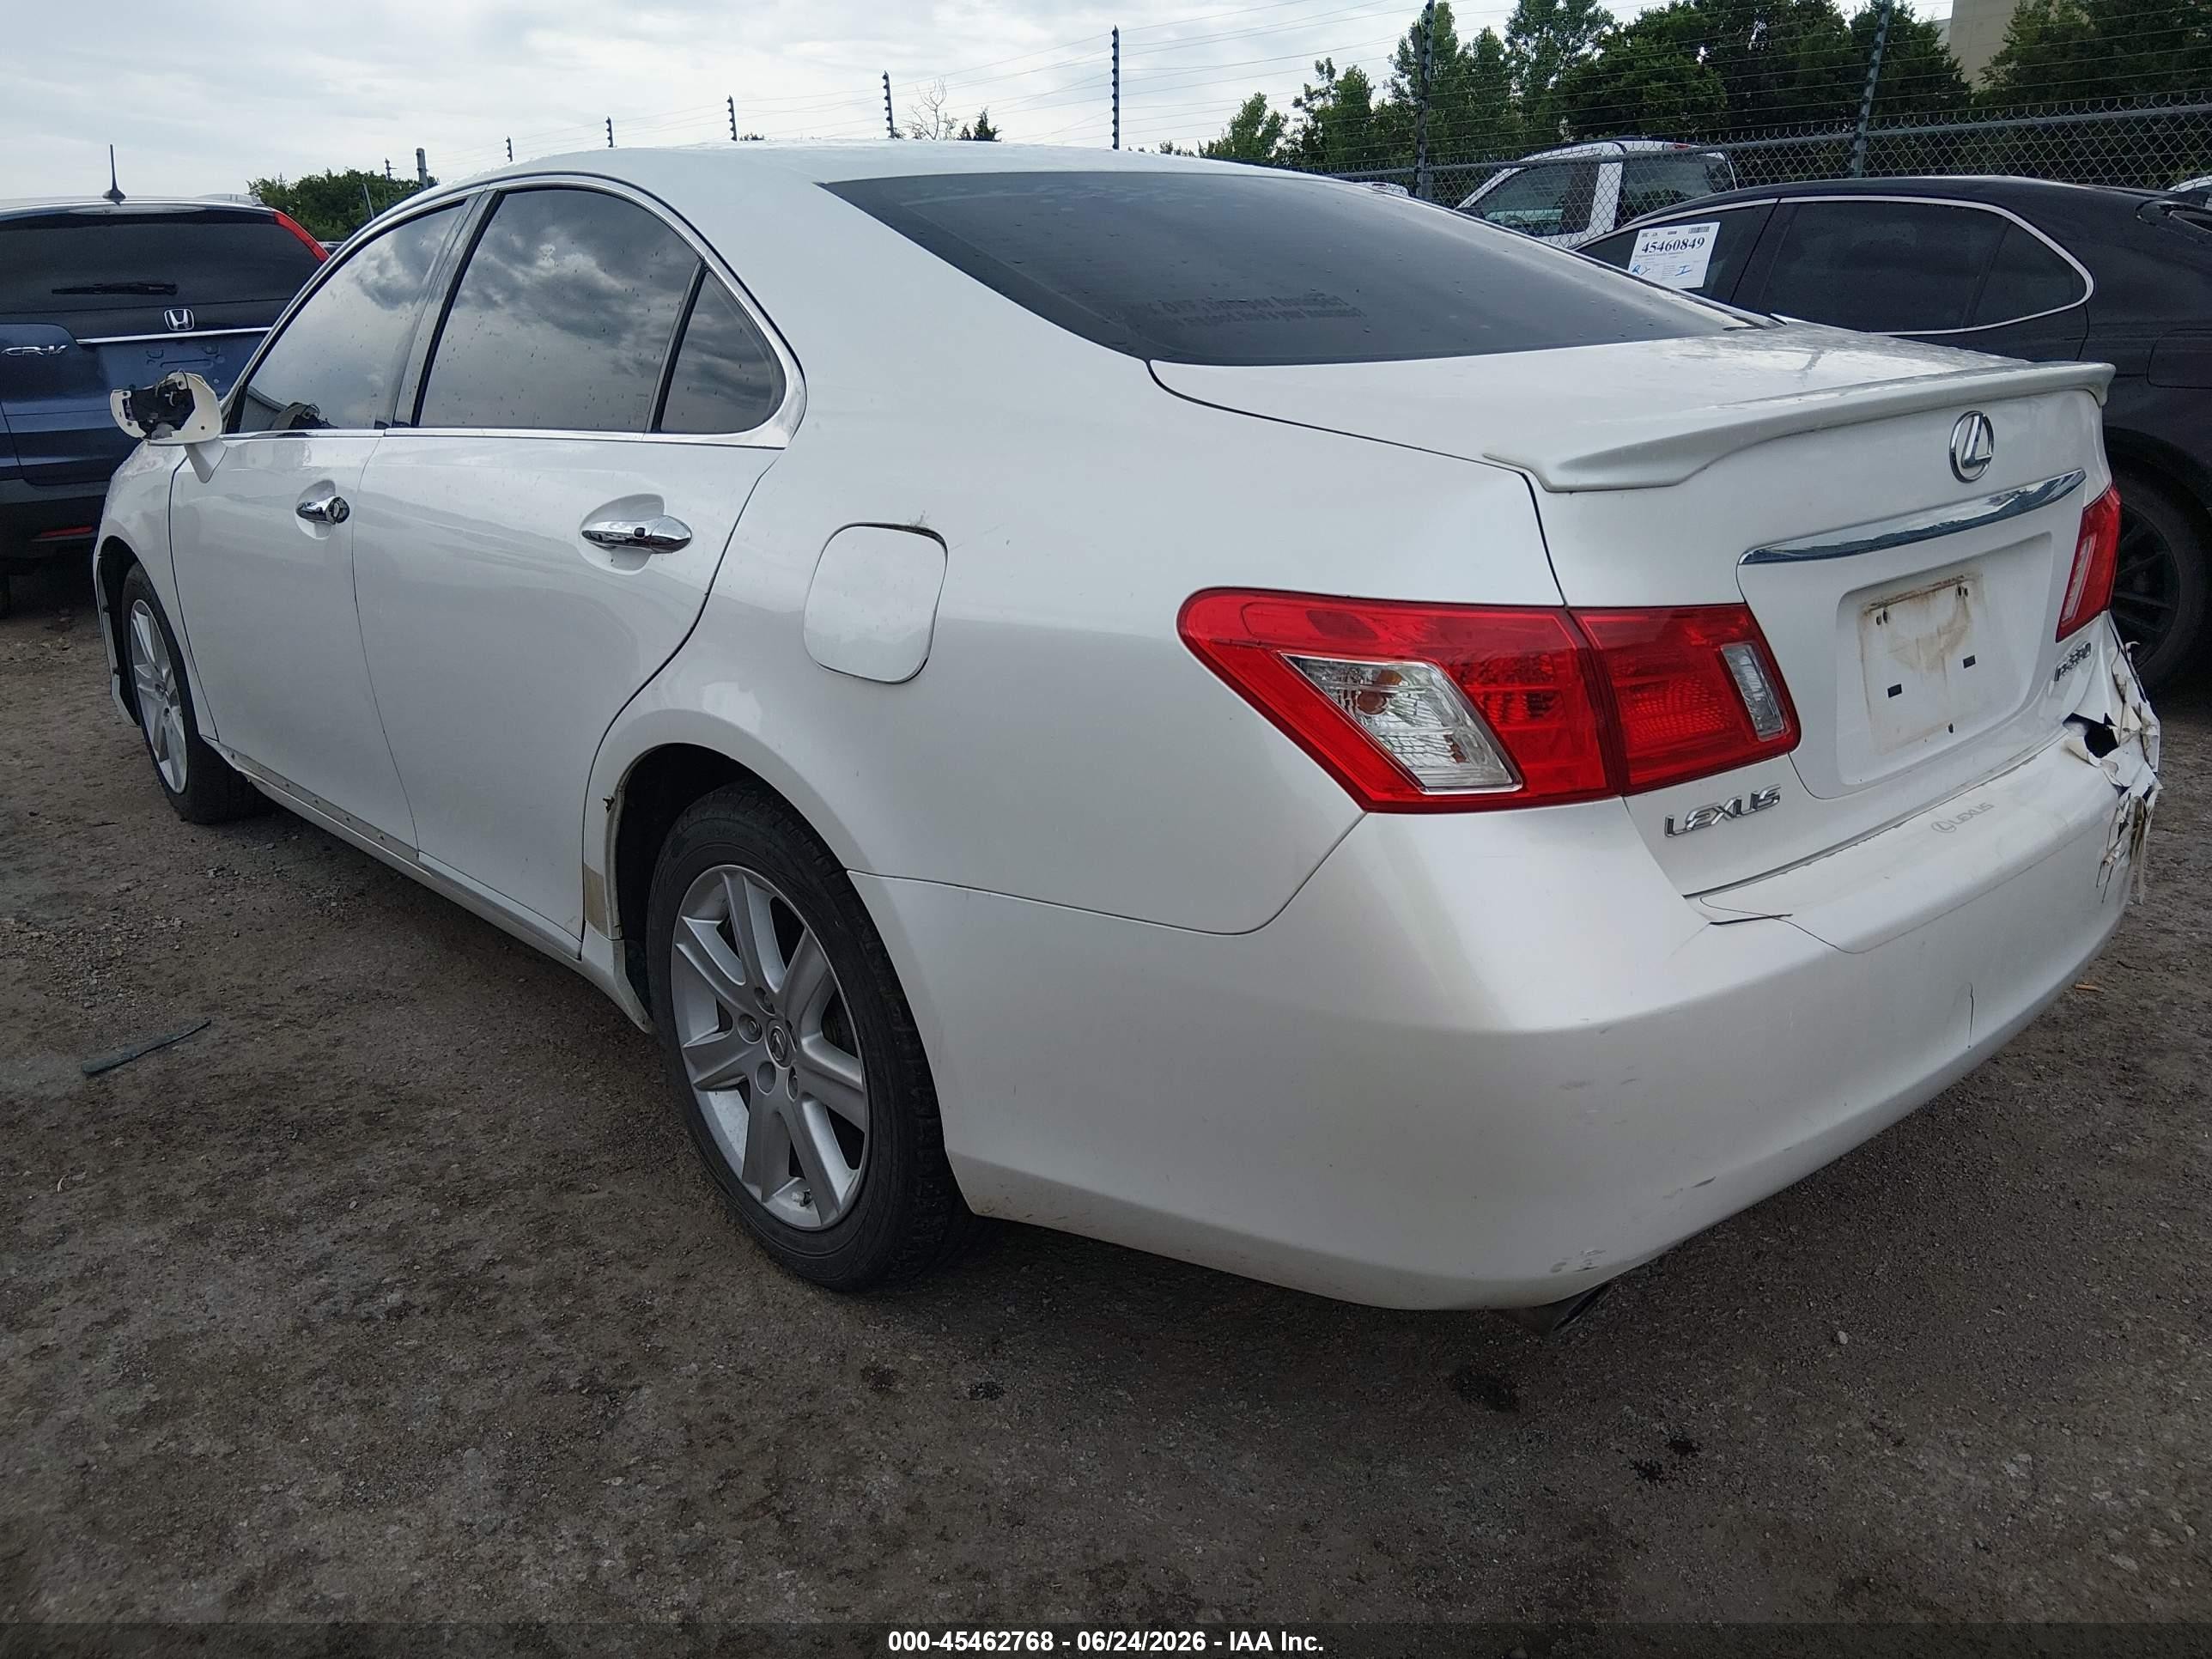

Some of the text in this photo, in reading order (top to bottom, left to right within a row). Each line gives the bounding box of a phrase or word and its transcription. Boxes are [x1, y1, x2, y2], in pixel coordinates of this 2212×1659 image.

[1641, 236, 1705, 253] 45460849
[2, 344, 68, 356] CR-V
[1664, 784, 1782, 838] LEXUS
